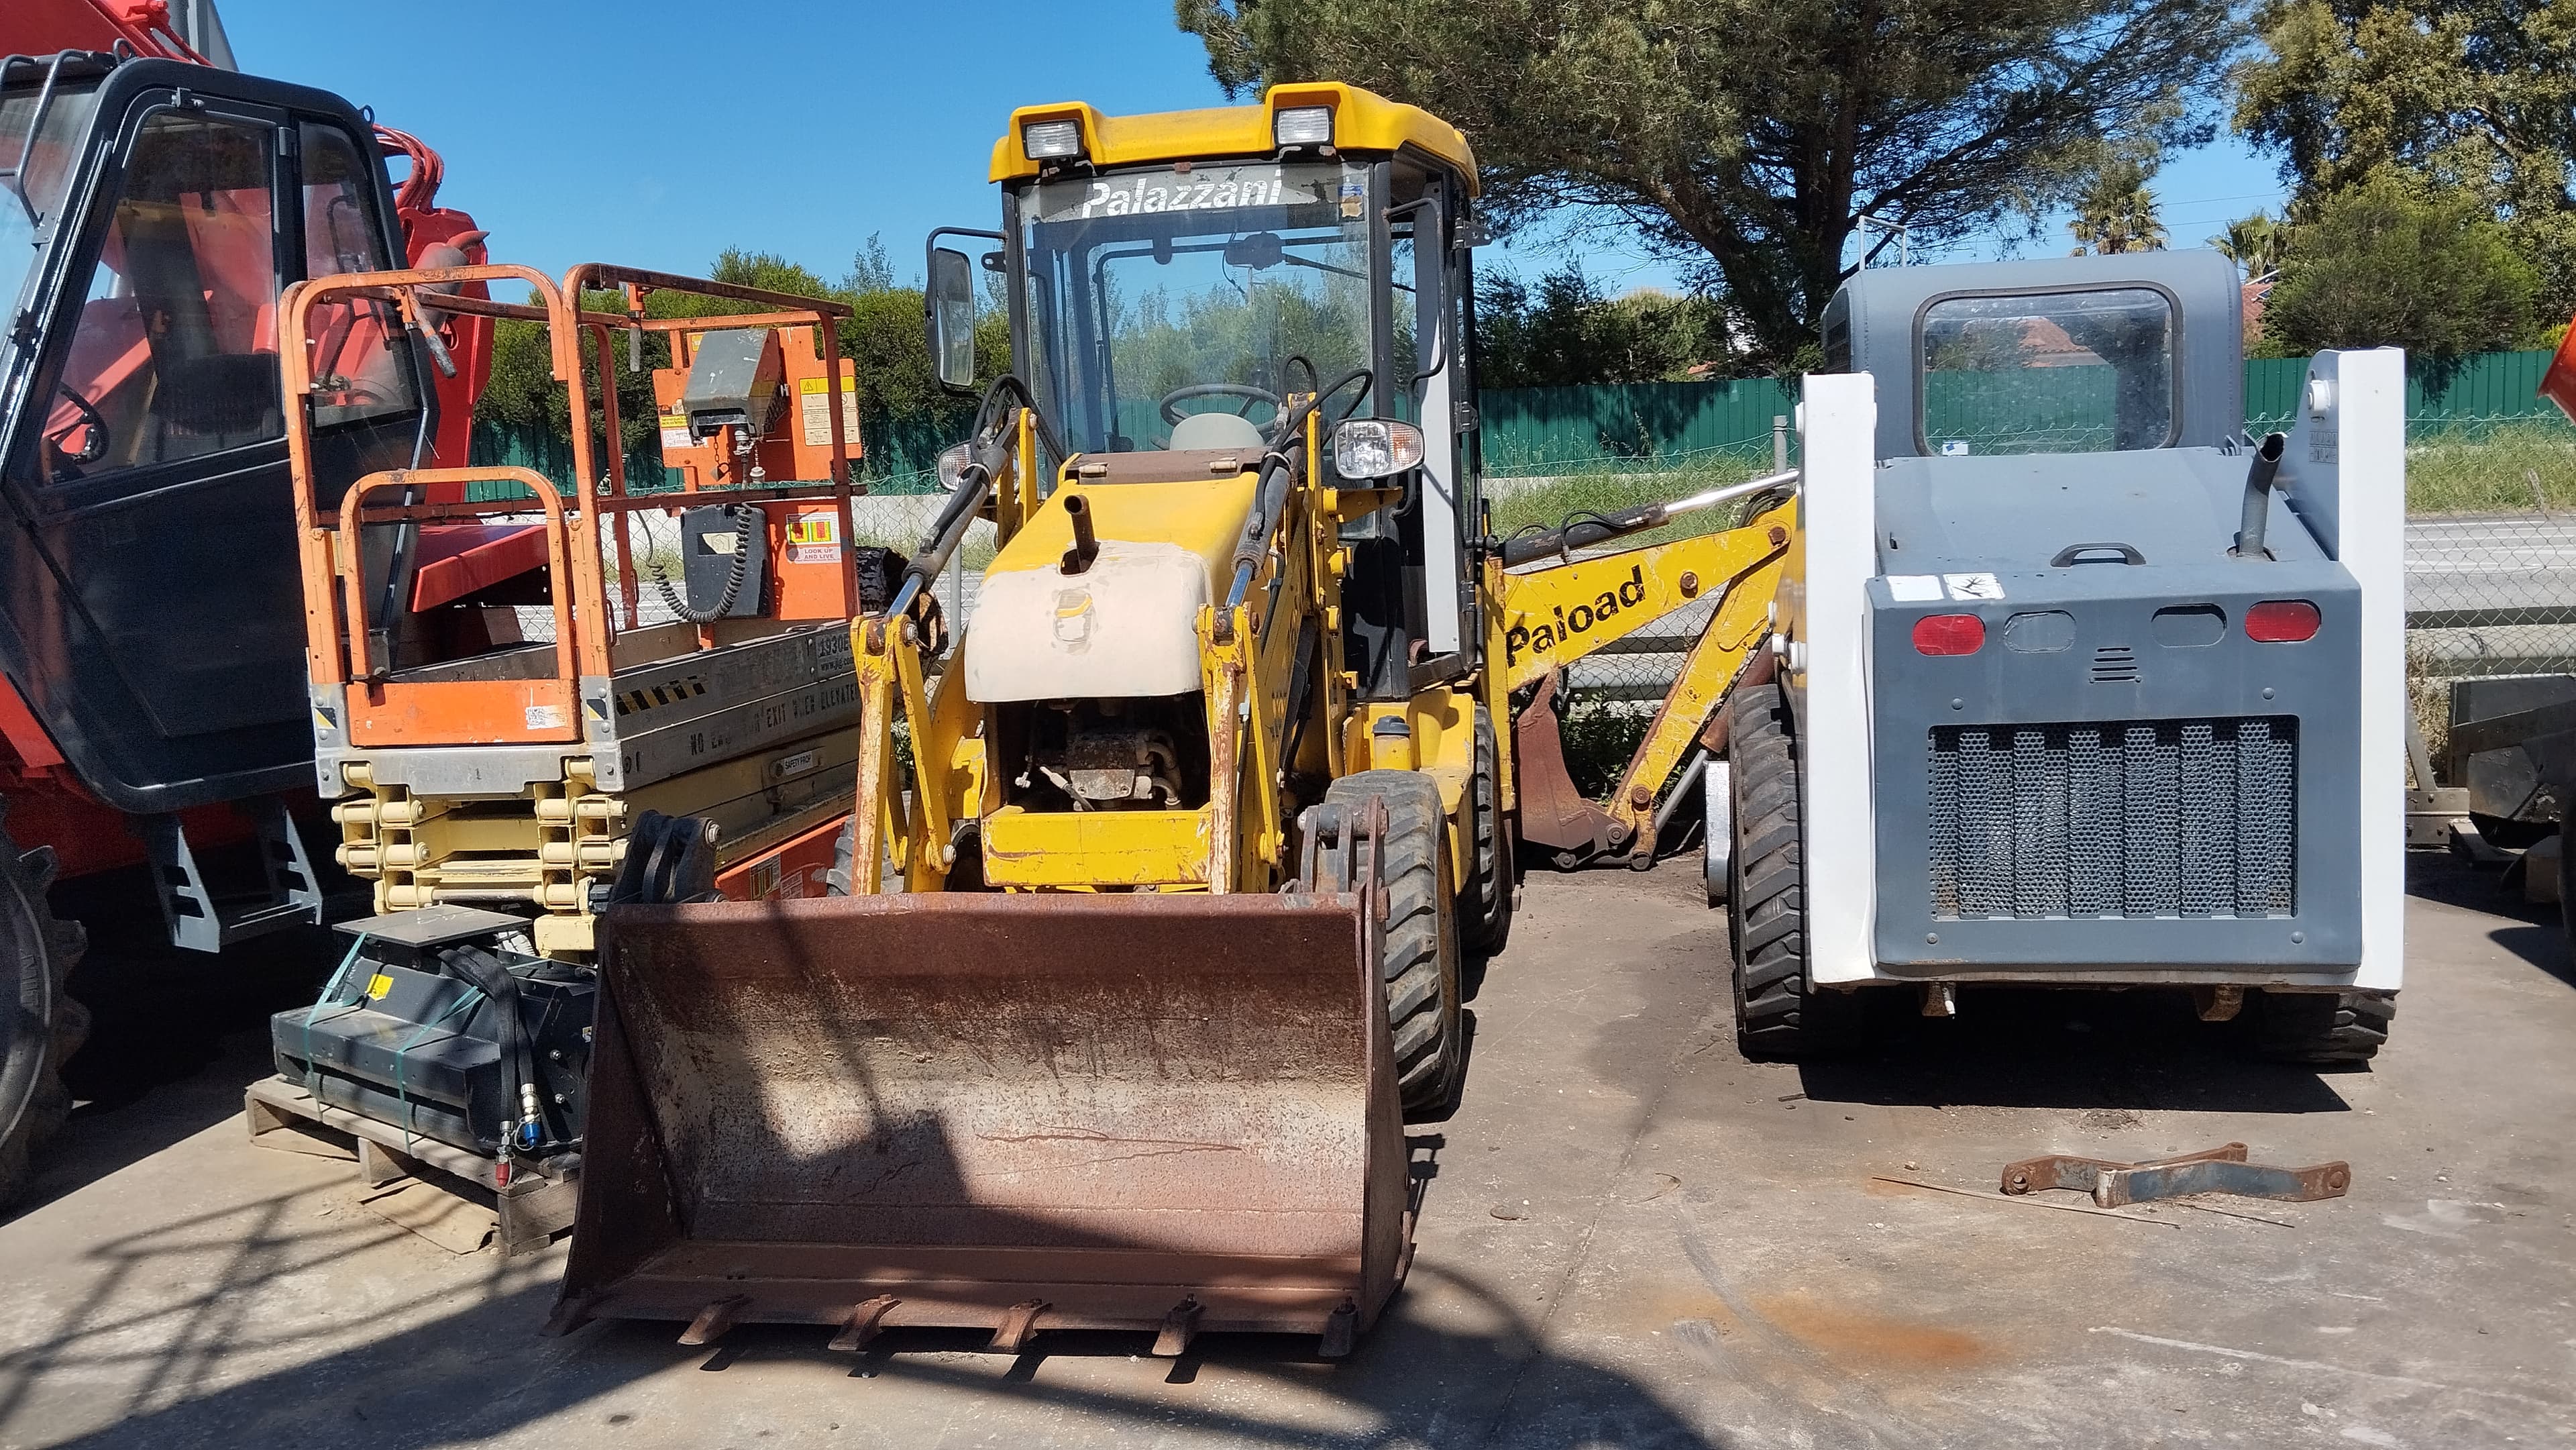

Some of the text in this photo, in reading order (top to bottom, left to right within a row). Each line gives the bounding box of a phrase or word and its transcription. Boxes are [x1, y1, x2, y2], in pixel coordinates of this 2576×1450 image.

[1081, 169, 1283, 219] Palazzani
[1507, 564, 1647, 668] Paload
[819, 633, 851, 658] 1930E
[690, 732, 704, 756] NO
[766, 703, 787, 728] EXIT
